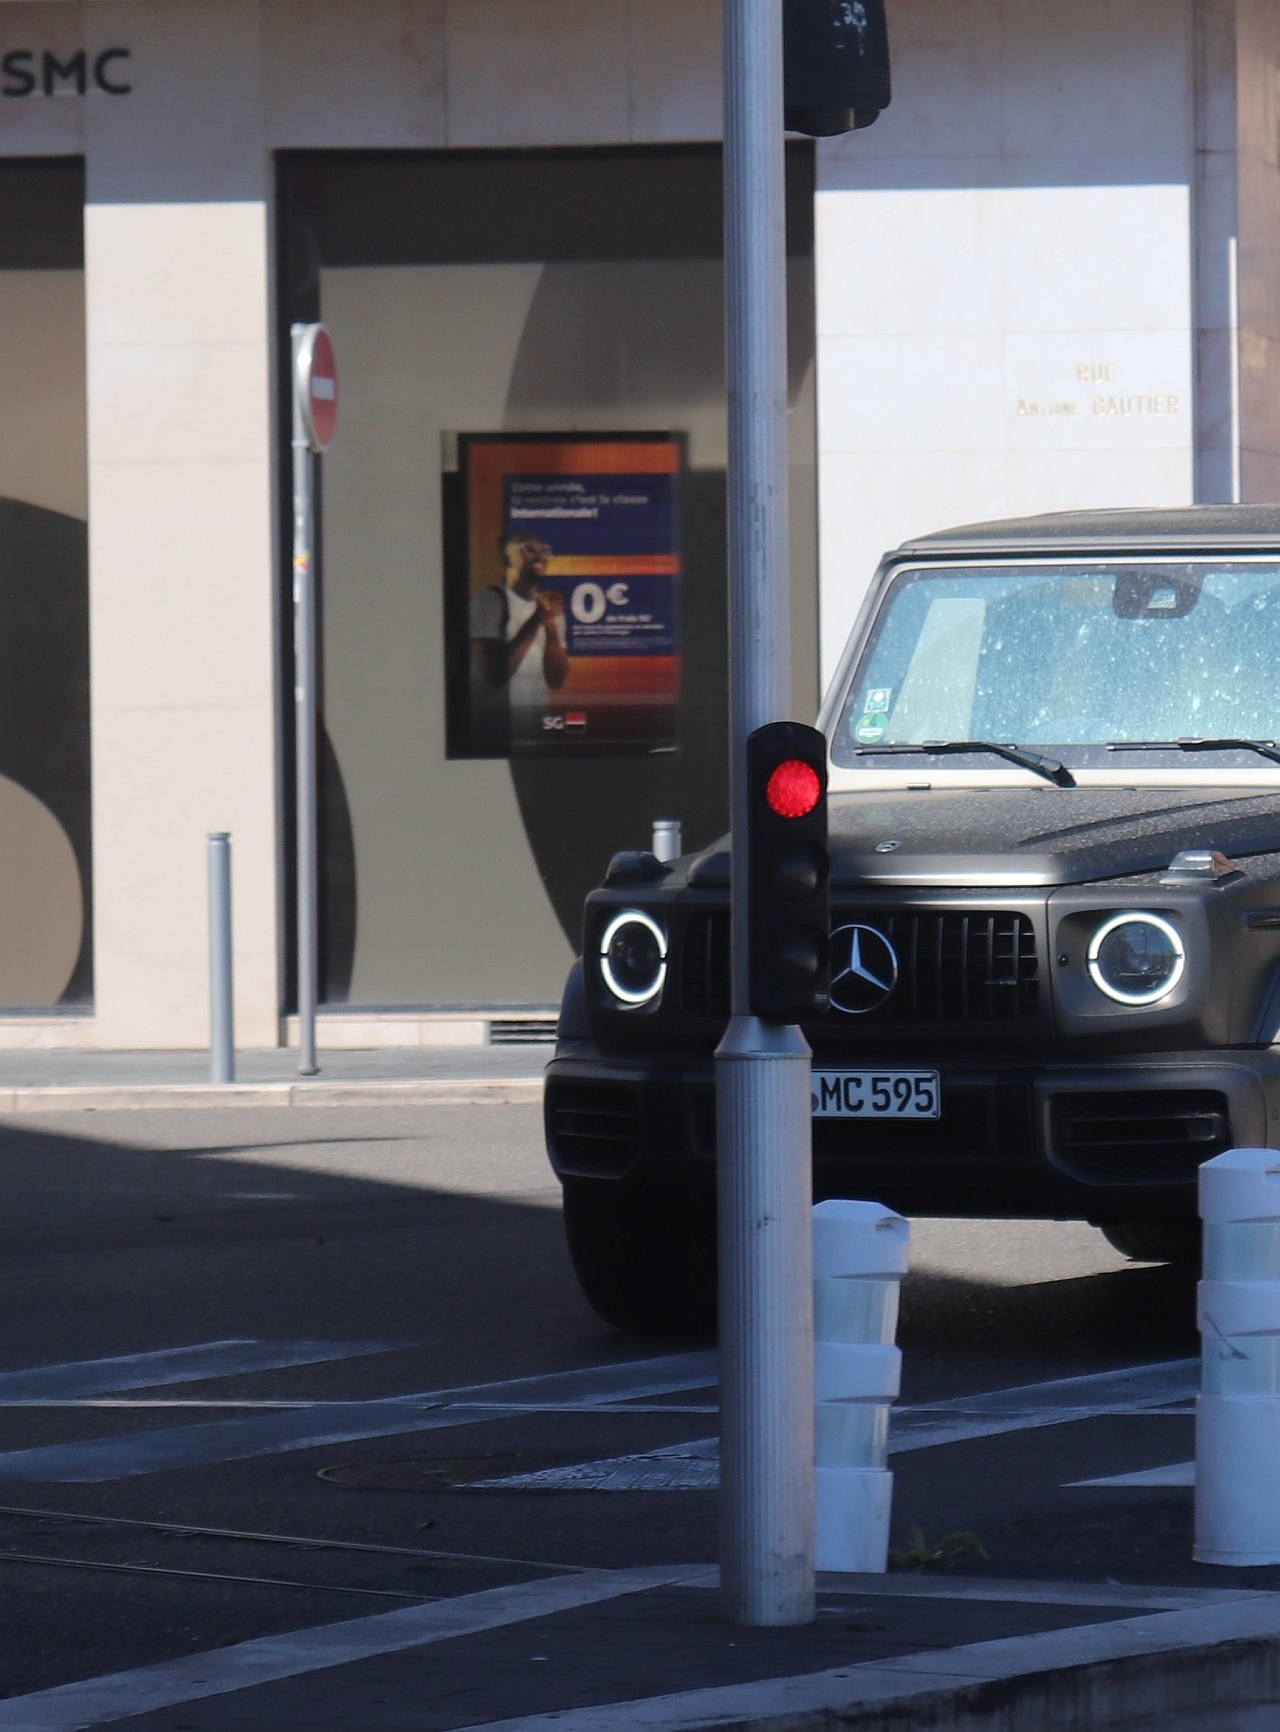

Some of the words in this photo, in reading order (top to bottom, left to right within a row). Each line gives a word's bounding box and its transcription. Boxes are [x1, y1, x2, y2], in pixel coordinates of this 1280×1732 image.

[1, 47, 132, 97] SMC
[1076, 363, 1116, 383] RUE
[1092, 394, 1180, 417] GAUTIER
[543, 716, 564, 730] SG
[820, 1077, 864, 1112] MC
[871, 1077, 934, 1112] 595
